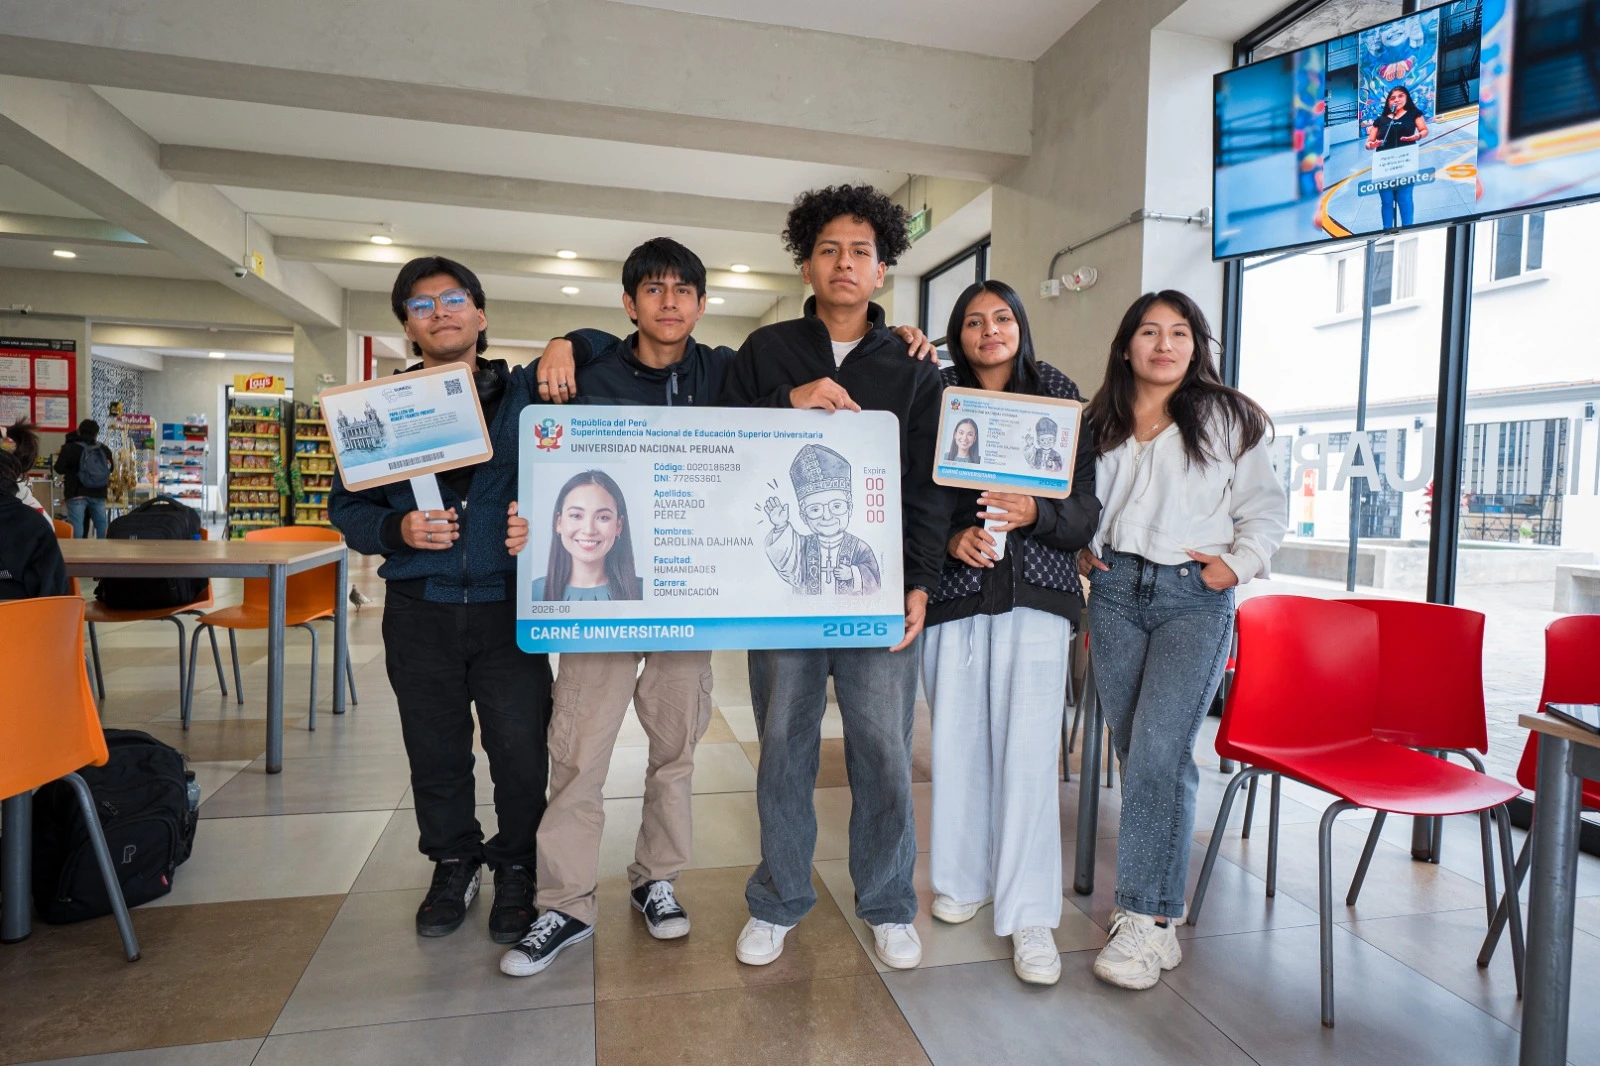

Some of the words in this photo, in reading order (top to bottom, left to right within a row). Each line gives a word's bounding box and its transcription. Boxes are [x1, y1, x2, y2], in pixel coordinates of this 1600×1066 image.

[1359, 171, 1434, 193] consciente,
[249, 376, 271, 391] Lay's
[570, 418, 612, 428] República
[613, 419, 626, 427] del
[628, 419, 648, 427] Perú
[570, 428, 644, 438] Superintendencia
[645, 429, 681, 437] Nacional
[682, 429, 693, 437] de
[694, 429, 736, 438] Educación
[738, 430, 771, 439] Superior
[773, 430, 823, 439] Universitaria
[570, 444, 637, 453] UNIVERSIDAD
[639, 444, 688, 453] NACIONAL
[689, 445, 735, 454] PERUANA
[654, 463, 685, 473] Código:
[863, 467, 886, 475] Expira
[654, 474, 671, 482] DNI:
[673, 475, 722, 483] 772653601
[958, 470, 997, 479] UNIVERSITARIO
[865, 477, 884, 491] 00
[1039, 479, 1063, 488] 2026
[654, 490, 694, 498] Apellidos:
[653, 499, 705, 508] ALVARADO
[866, 493, 885, 507] 00
[654, 509, 686, 519] PÉREZ
[866, 509, 885, 523] 00
[654, 528, 694, 536] Nombres:
[654, 537, 704, 546] CAROLINA
[706, 537, 754, 546] DAJHANA
[654, 556, 692, 564] Facultad:
[654, 565, 716, 574] HUMANIDADES
[653, 579, 687, 587] Carrera:
[653, 587, 719, 597] COMUNICACIÓN
[532, 605, 570, 613] 2026-00
[530, 623, 580, 640] CARNÉ
[584, 625, 695, 640] UNIVERSITARIO
[823, 622, 888, 637] 2026
